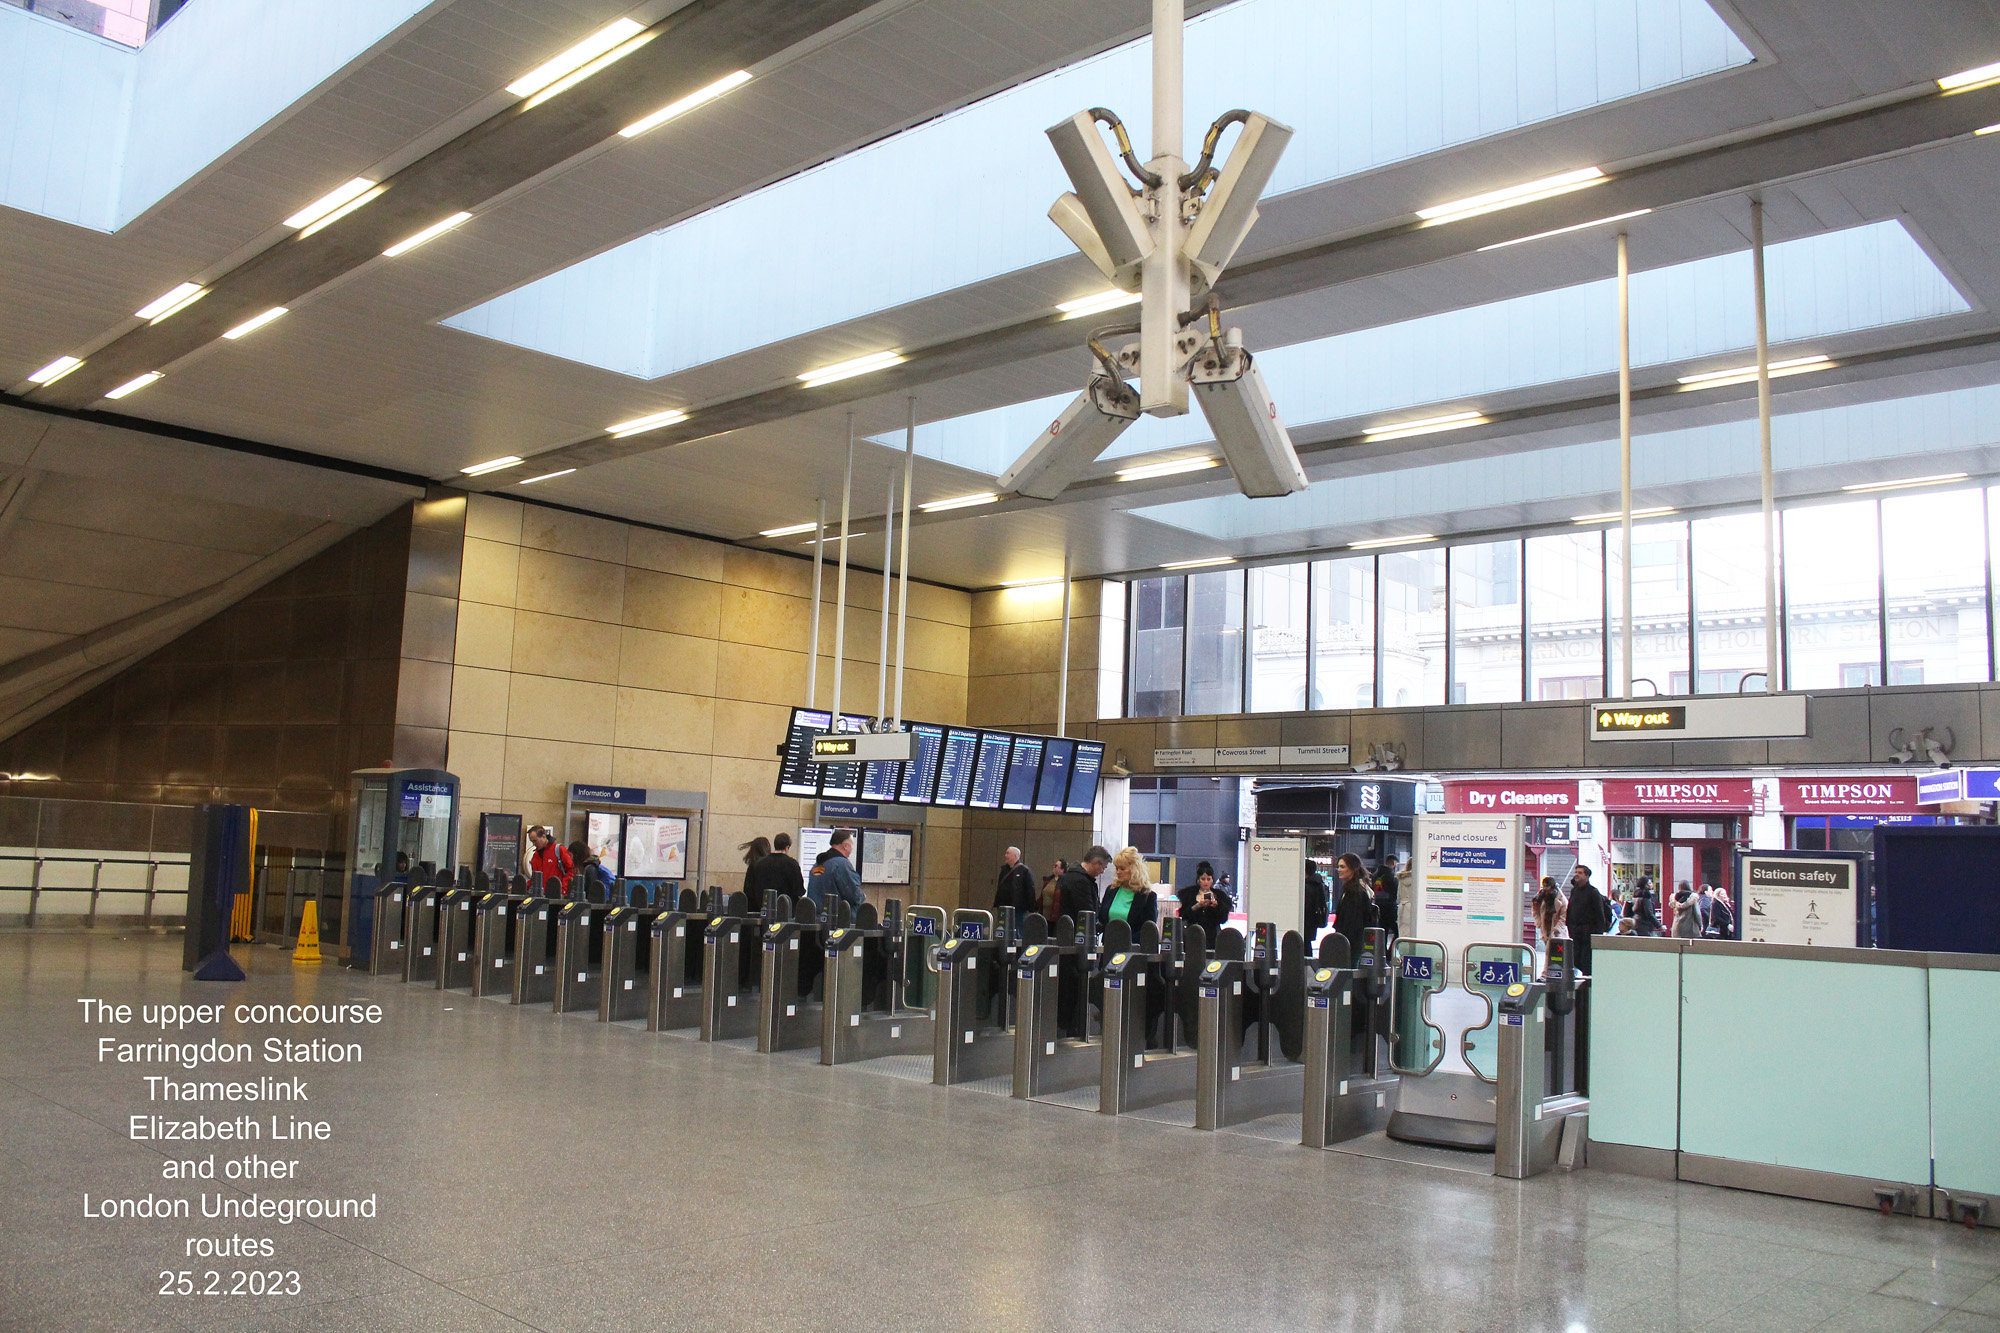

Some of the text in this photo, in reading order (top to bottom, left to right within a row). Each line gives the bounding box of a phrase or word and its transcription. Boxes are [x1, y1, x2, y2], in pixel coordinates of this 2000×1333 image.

[1502, 634, 1623, 661] FARINGDN
[1613, 712, 1671, 728] Way out
[823, 742, 849, 753] Way out
[408, 783, 448, 792] Assistance
[579, 789, 611, 798] Information
[1634, 784, 1718, 798] TIMPSON
[1798, 784, 1892, 798] TIMPSON
[1469, 790, 1569, 807] Dry Cleaners
[824, 805, 850, 813] Information
[1351, 815, 1374, 824] TRIPLE
[1428, 832, 1498, 842] Planned closures
[1753, 868, 1836, 884] Station safety
